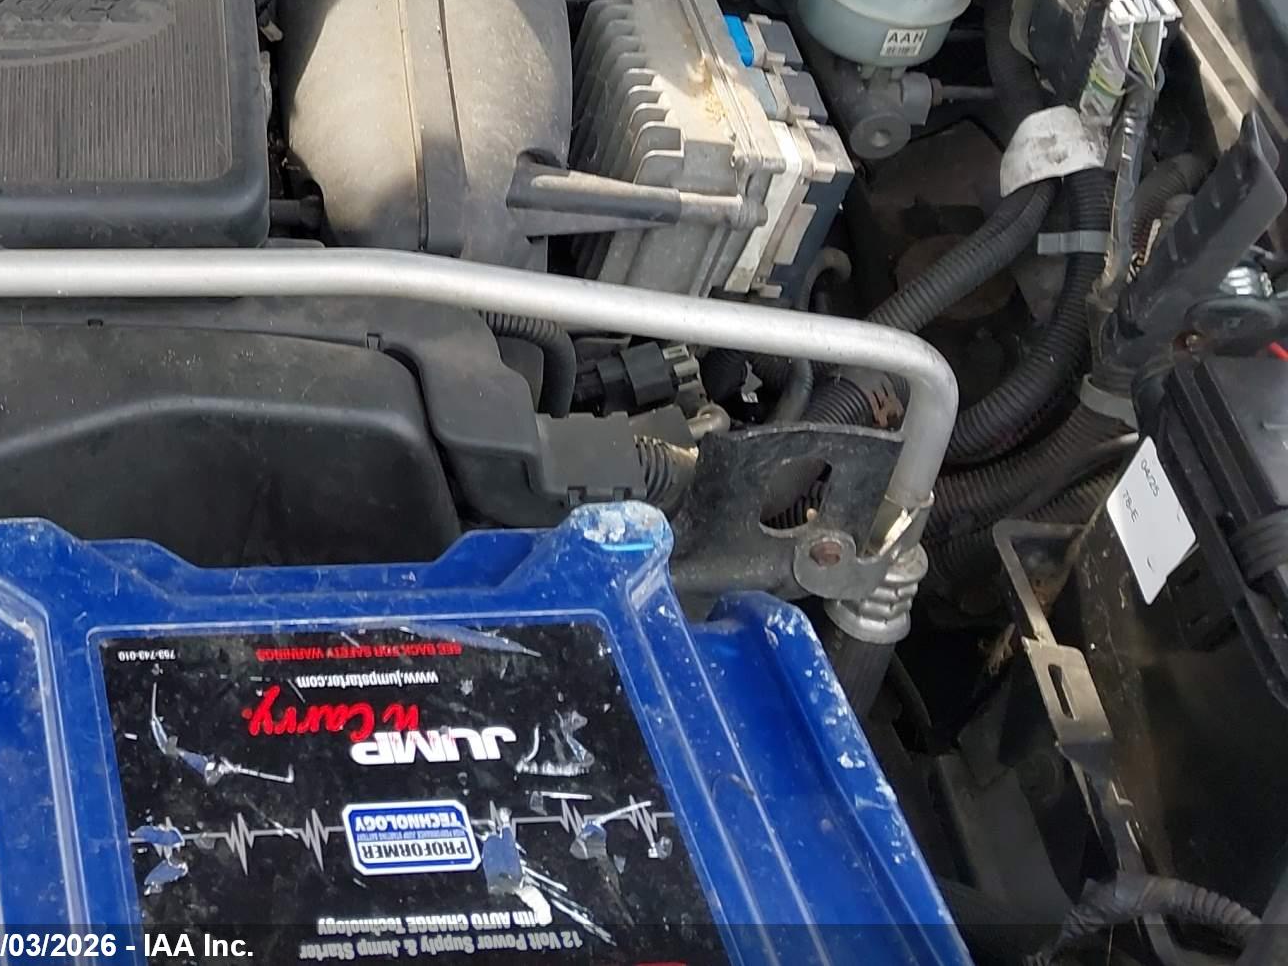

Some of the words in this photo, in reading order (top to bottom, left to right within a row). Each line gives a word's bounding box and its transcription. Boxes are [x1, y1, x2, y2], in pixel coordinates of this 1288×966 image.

[296, 670, 439, 690] www.jumpstarter.com
[350, 726, 517, 767] JUMP
[354, 812, 461, 831] TECHNOLOGY
[361, 841, 467, 859] PROFORMER
[317, 916, 404, 937] Technology
[406, 915, 467, 932] CHARGE
[472, 912, 511, 929] AUTO
[356, 937, 401, 958] Jump
[404, 939, 417, 955] &
[421, 933, 473, 954] Supply
[478, 933, 526, 951] Power
[529, 931, 561, 949] Volt
[562, 930, 583, 948] 12
[300, 942, 353, 961] Starter
